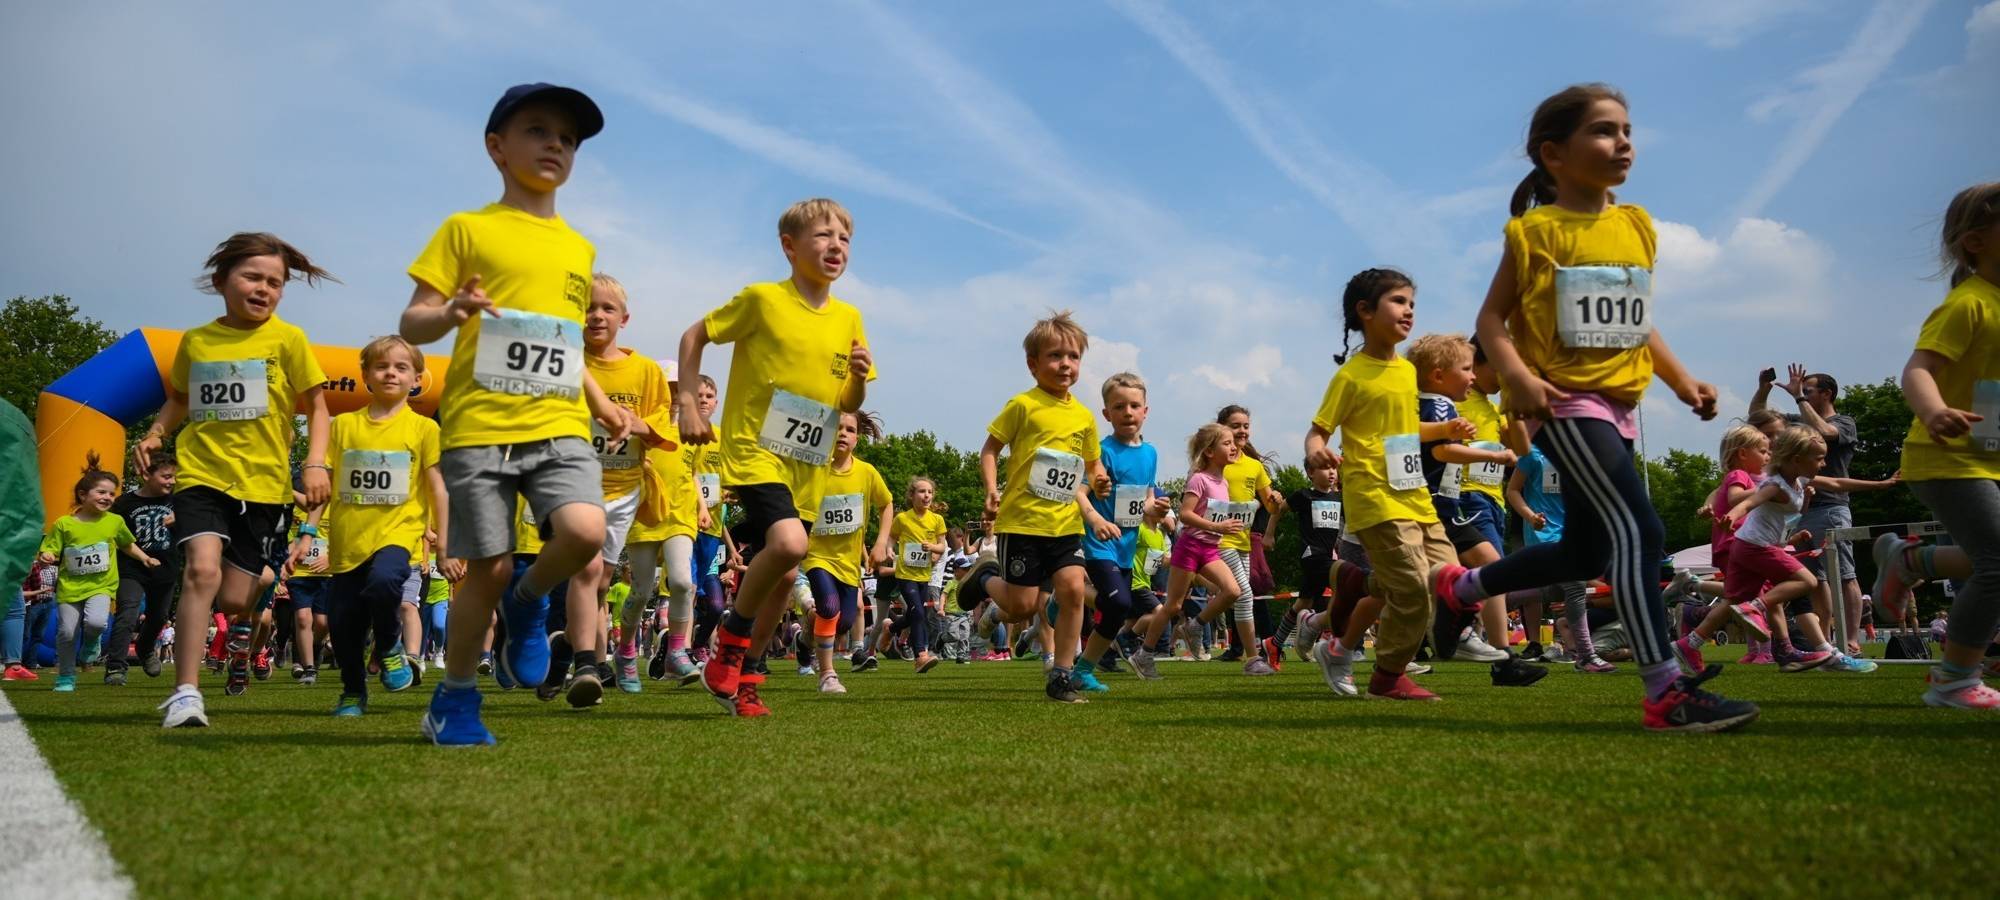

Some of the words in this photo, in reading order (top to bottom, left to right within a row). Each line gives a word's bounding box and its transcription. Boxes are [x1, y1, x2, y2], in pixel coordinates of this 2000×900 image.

[1575, 295, 1644, 326] 1010
[506, 341, 566, 377] 975
[200, 382, 246, 405] 820
[784, 417, 824, 448] 730
[349, 469, 392, 490] 690
[1045, 467, 1076, 491] 932
[824, 508, 854, 525] 958
[1321, 510, 1338, 522] 940
[75, 553, 102, 568] 743
[910, 551, 927, 561] 974
